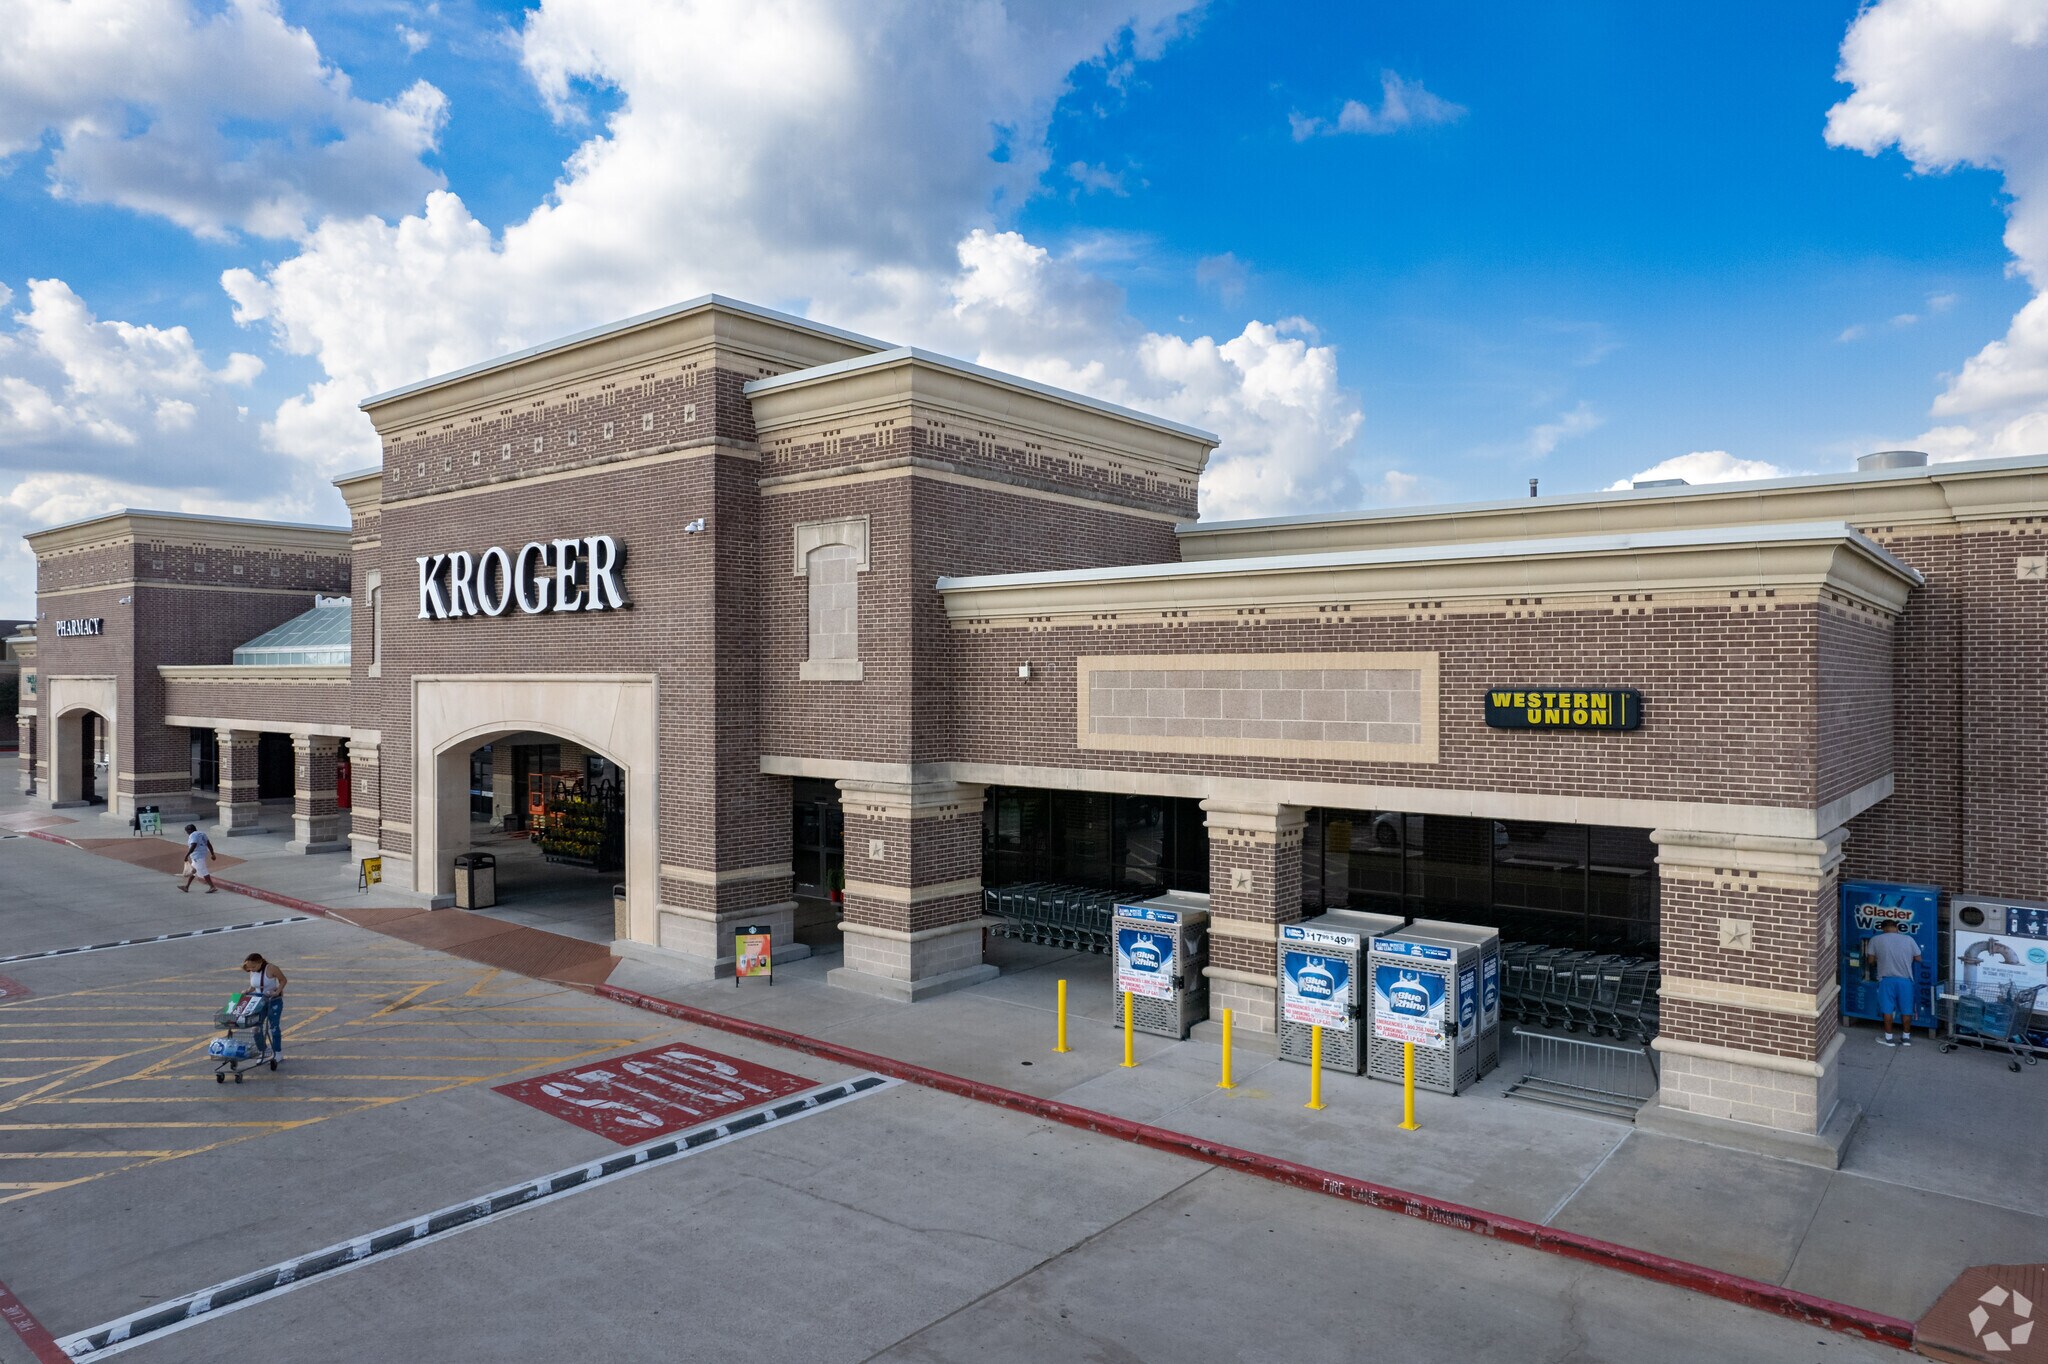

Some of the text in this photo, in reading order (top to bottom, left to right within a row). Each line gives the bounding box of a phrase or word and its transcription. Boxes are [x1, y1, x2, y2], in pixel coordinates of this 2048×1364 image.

[416, 535, 623, 619] KROGER
[56, 617, 99, 637] PHARMACY
[1492, 693, 1607, 708] WESTERN
[1527, 709, 1607, 725] UNION
[1863, 905, 1913, 920] Glacier
[1856, 917, 1919, 934] Waer
[1137, 951, 1155, 960] Blue
[1136, 959, 1158, 968] Rhino
[1306, 976, 1327, 986] Blue
[1461, 975, 1474, 986] RHINO
[1304, 984, 1331, 995] Rhino
[1398, 992, 1421, 1002] Blue
[1396, 1000, 1425, 1011] Rhino
[540, 1050, 771, 1129] STOP
[1322, 1178, 1471, 1230] FIRE LANE NO PARKING
